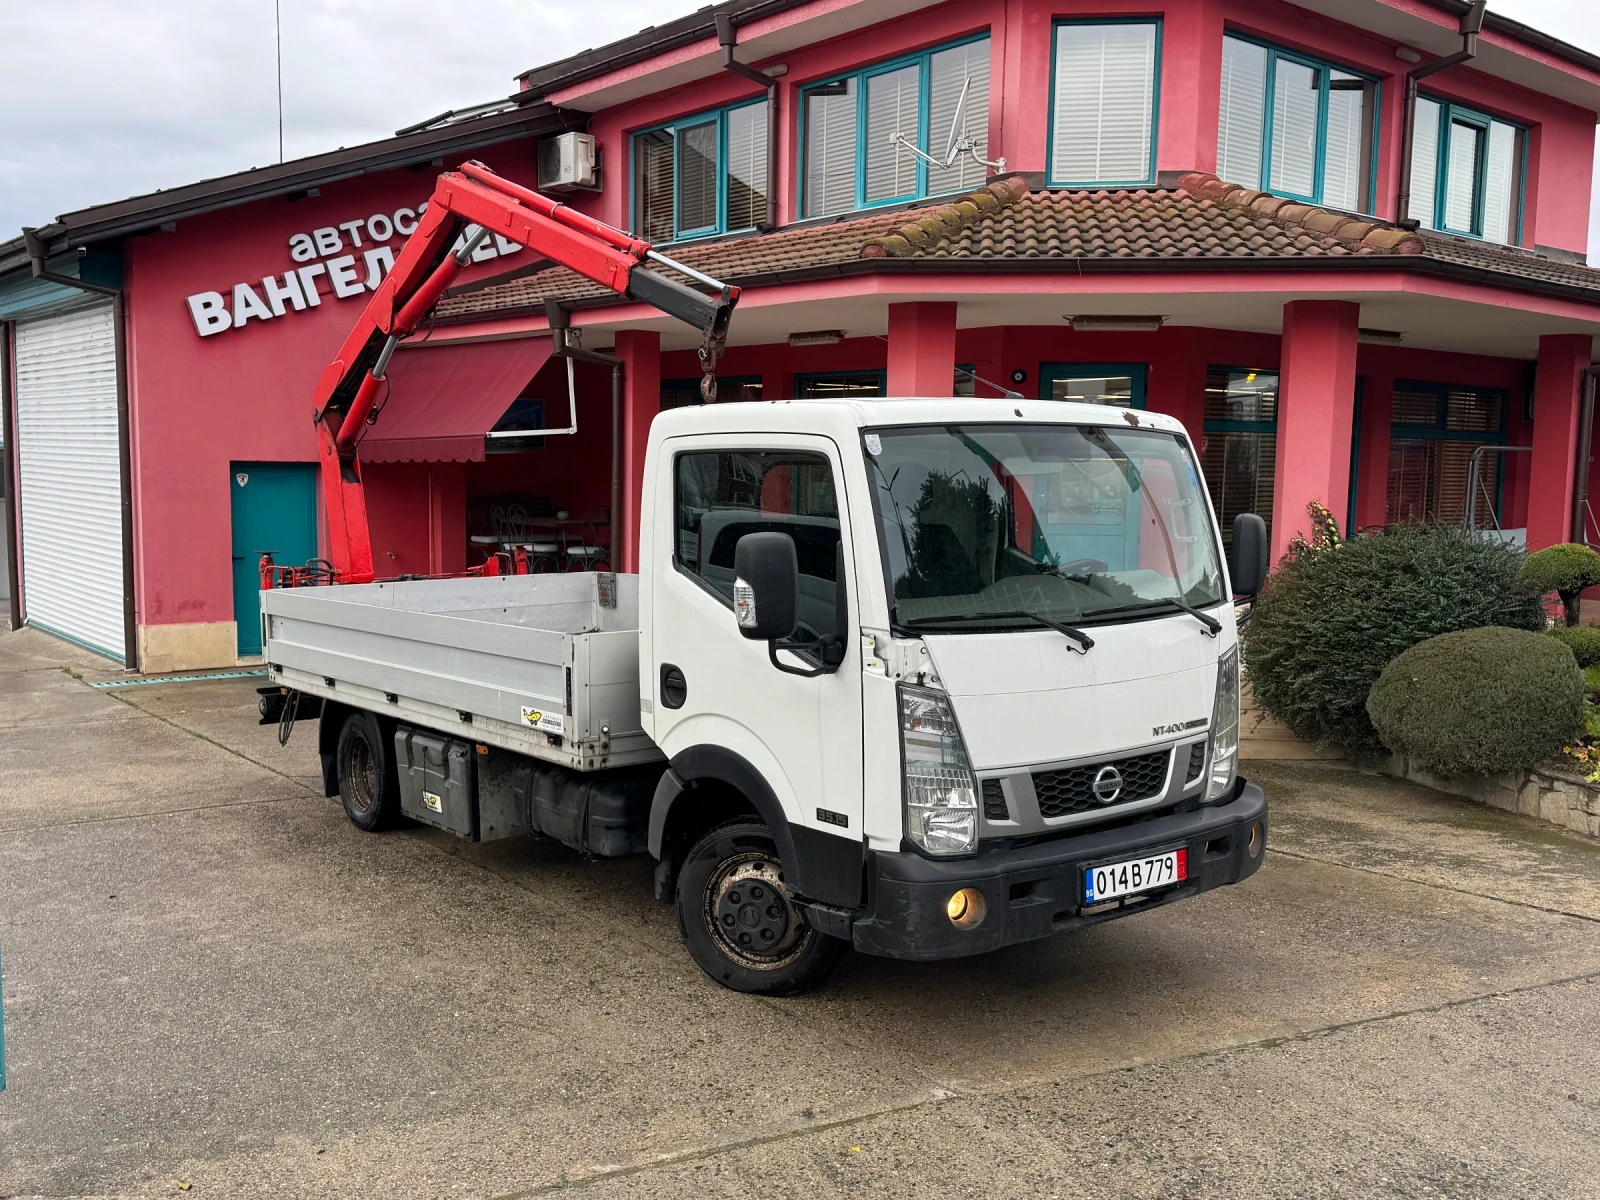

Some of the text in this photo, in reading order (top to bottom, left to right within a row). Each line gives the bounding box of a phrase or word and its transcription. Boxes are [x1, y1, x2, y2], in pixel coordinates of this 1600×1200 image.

[1152, 722, 1185, 737] NT400
[1098, 781, 1121, 791] NISSAN
[1085, 889, 1094, 898] BG
